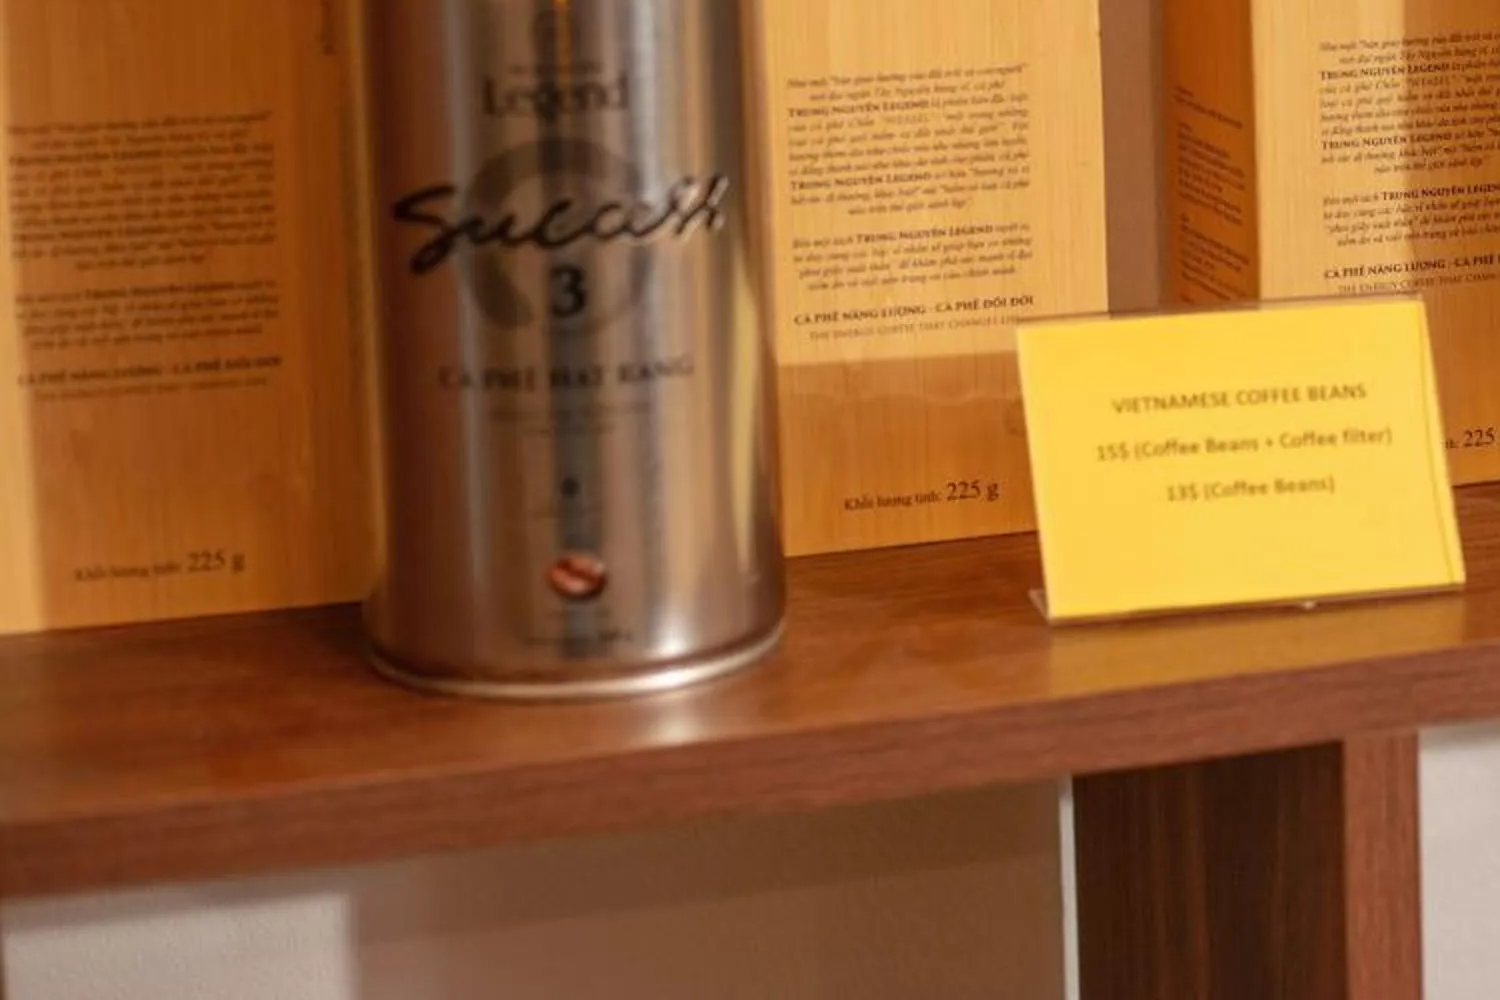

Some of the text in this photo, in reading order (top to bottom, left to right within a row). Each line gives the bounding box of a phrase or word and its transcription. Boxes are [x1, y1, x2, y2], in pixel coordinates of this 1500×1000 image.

[390, 173, 729, 276] Success
[550, 266, 587, 319] 3
[1111, 382, 1368, 415] VIETNAMESE COFFEE BEANS
[1097, 426, 1394, 463] 15$ (Coffee Beans + Coffee filter)
[1462, 426, 1496, 448] 225
[947, 479, 982, 501] 225
[986, 481, 1000, 502] g
[1203, 477, 1269, 502] (Coffee
[1273, 474, 1337, 496] Beans)
[187, 549, 227, 573] 225
